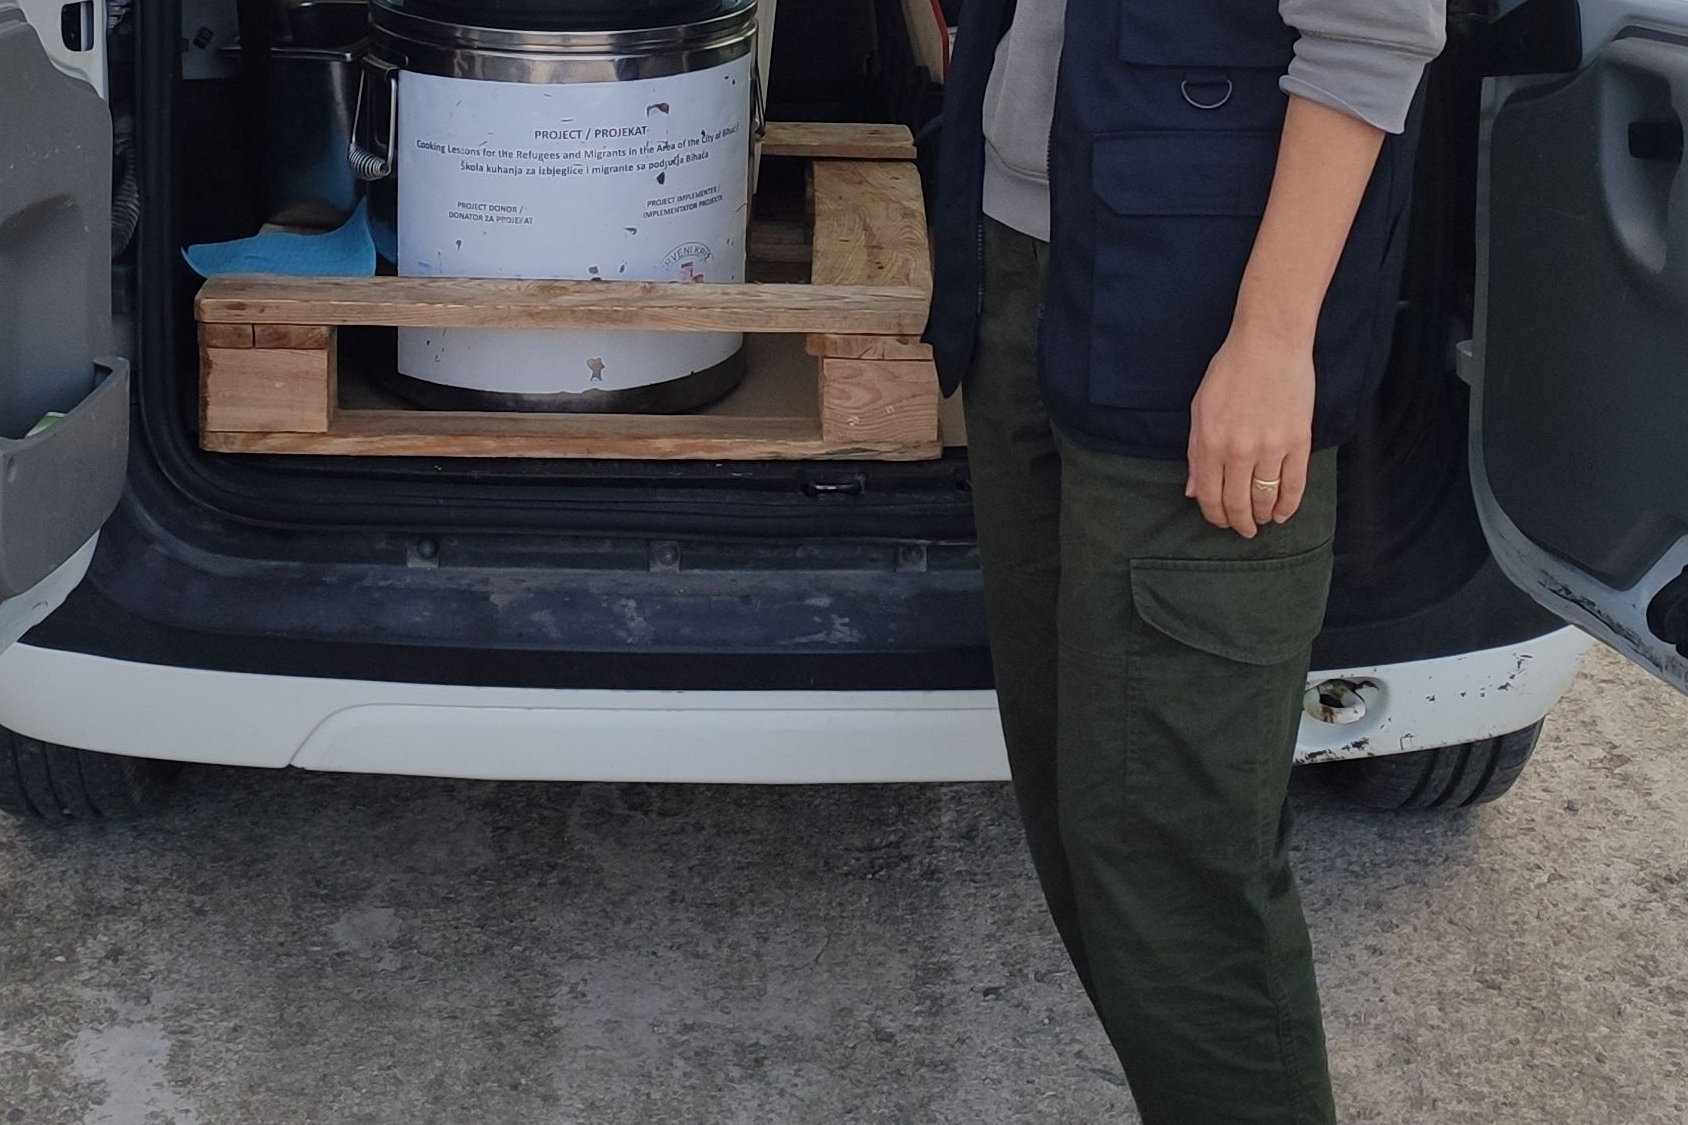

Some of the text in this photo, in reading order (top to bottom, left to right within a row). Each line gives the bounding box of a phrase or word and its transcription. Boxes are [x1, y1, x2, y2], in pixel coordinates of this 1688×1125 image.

[534, 126, 648, 140] PROJECT / PROJEKAT
[416, 139, 446, 154] Cooking
[482, 148, 496, 158] for
[498, 149, 514, 159] the
[516, 150, 561, 163] Refugees
[562, 150, 581, 160] and
[583, 149, 627, 161] Migrants
[628, 147, 638, 156] in
[639, 142, 655, 155] the
[656, 141, 676, 153] Area
[677, 139, 687, 150] of
[687, 137, 700, 148] the
[460, 160, 484, 172] Škola
[486, 162, 523, 176] kuhanja
[525, 165, 536, 175] za
[538, 164, 584, 177] izbjeglice
[591, 162, 634, 175] migrante
[636, 163, 646, 171] sa
[685, 151, 709, 163] Bihaća
[457, 201, 487, 212] PROJECT
[488, 204, 518, 213] DONOR
[646, 195, 675, 208] PROJECT
[448, 211, 483, 222] DONATOR
[484, 213, 495, 222] ZA
[642, 202, 698, 219] IMPLEMENTATOR
